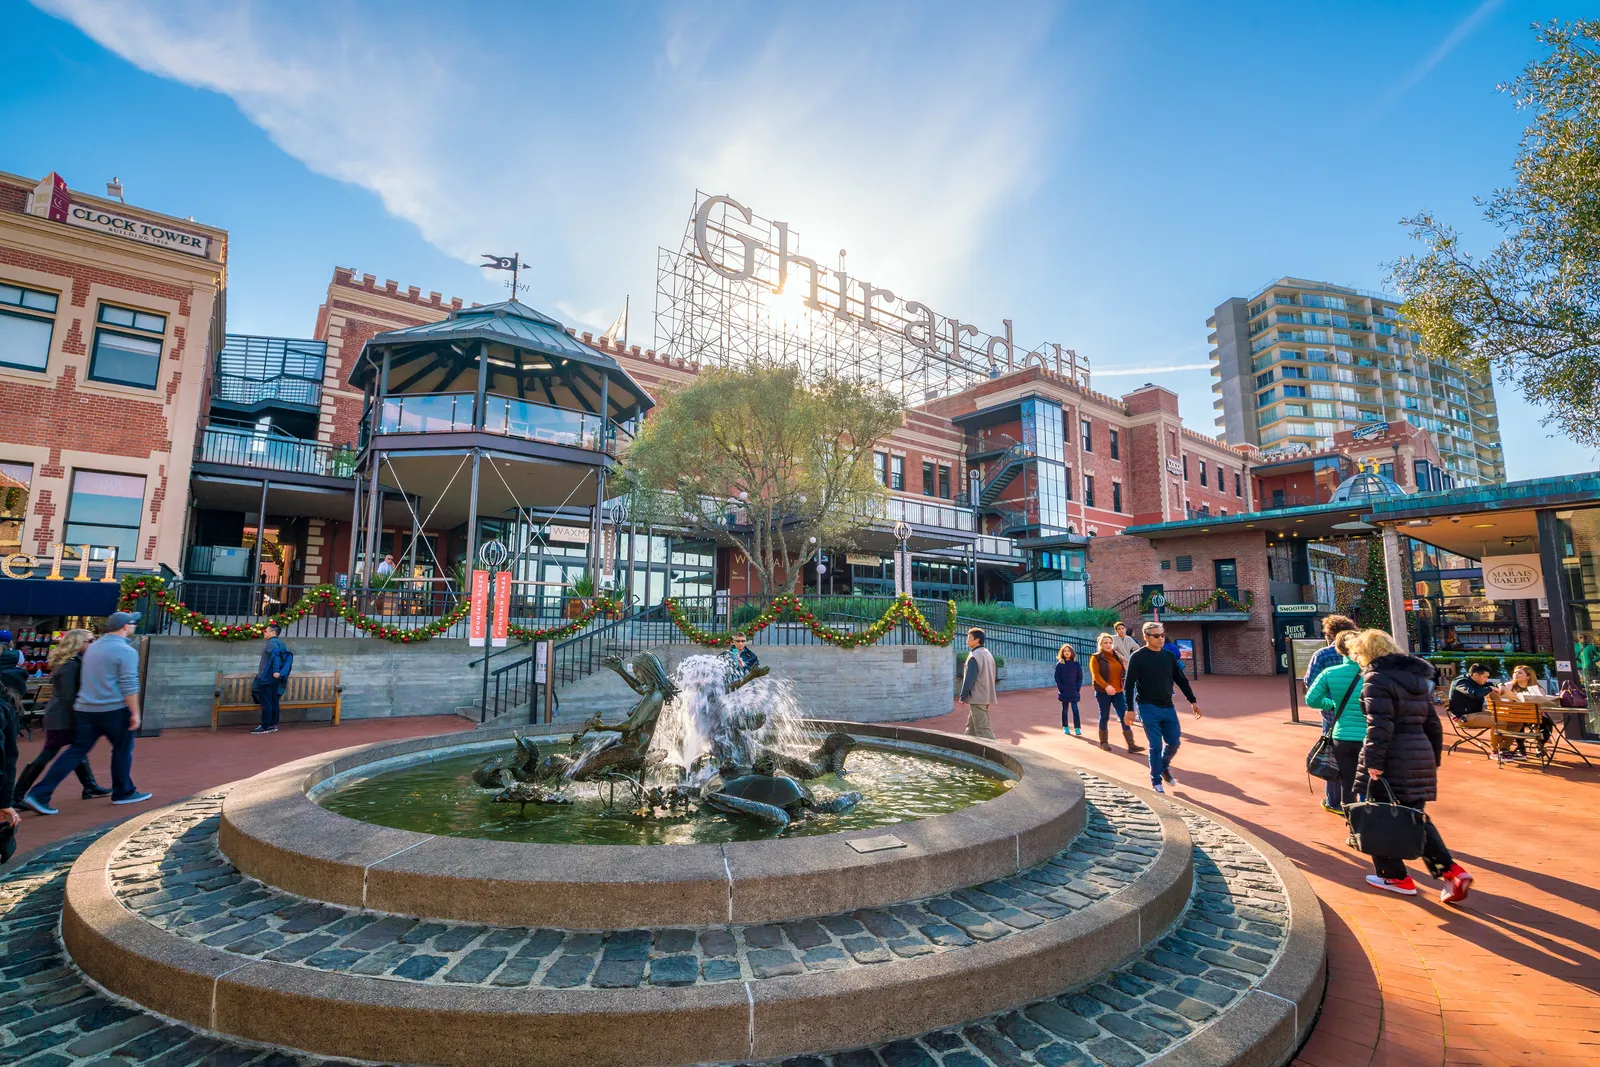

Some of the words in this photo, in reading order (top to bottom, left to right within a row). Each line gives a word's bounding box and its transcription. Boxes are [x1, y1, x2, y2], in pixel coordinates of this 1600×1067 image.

[72, 208, 137, 232] CLOCK
[140, 224, 202, 248] TOWER
[108, 227, 150, 241] BUILDING
[1492, 569, 1533, 578] MARAIS
[1494, 576, 1532, 584] BAKERY
[497, 600, 505, 635] FOUNTAIN
[1284, 624, 1305, 635] JUICE
